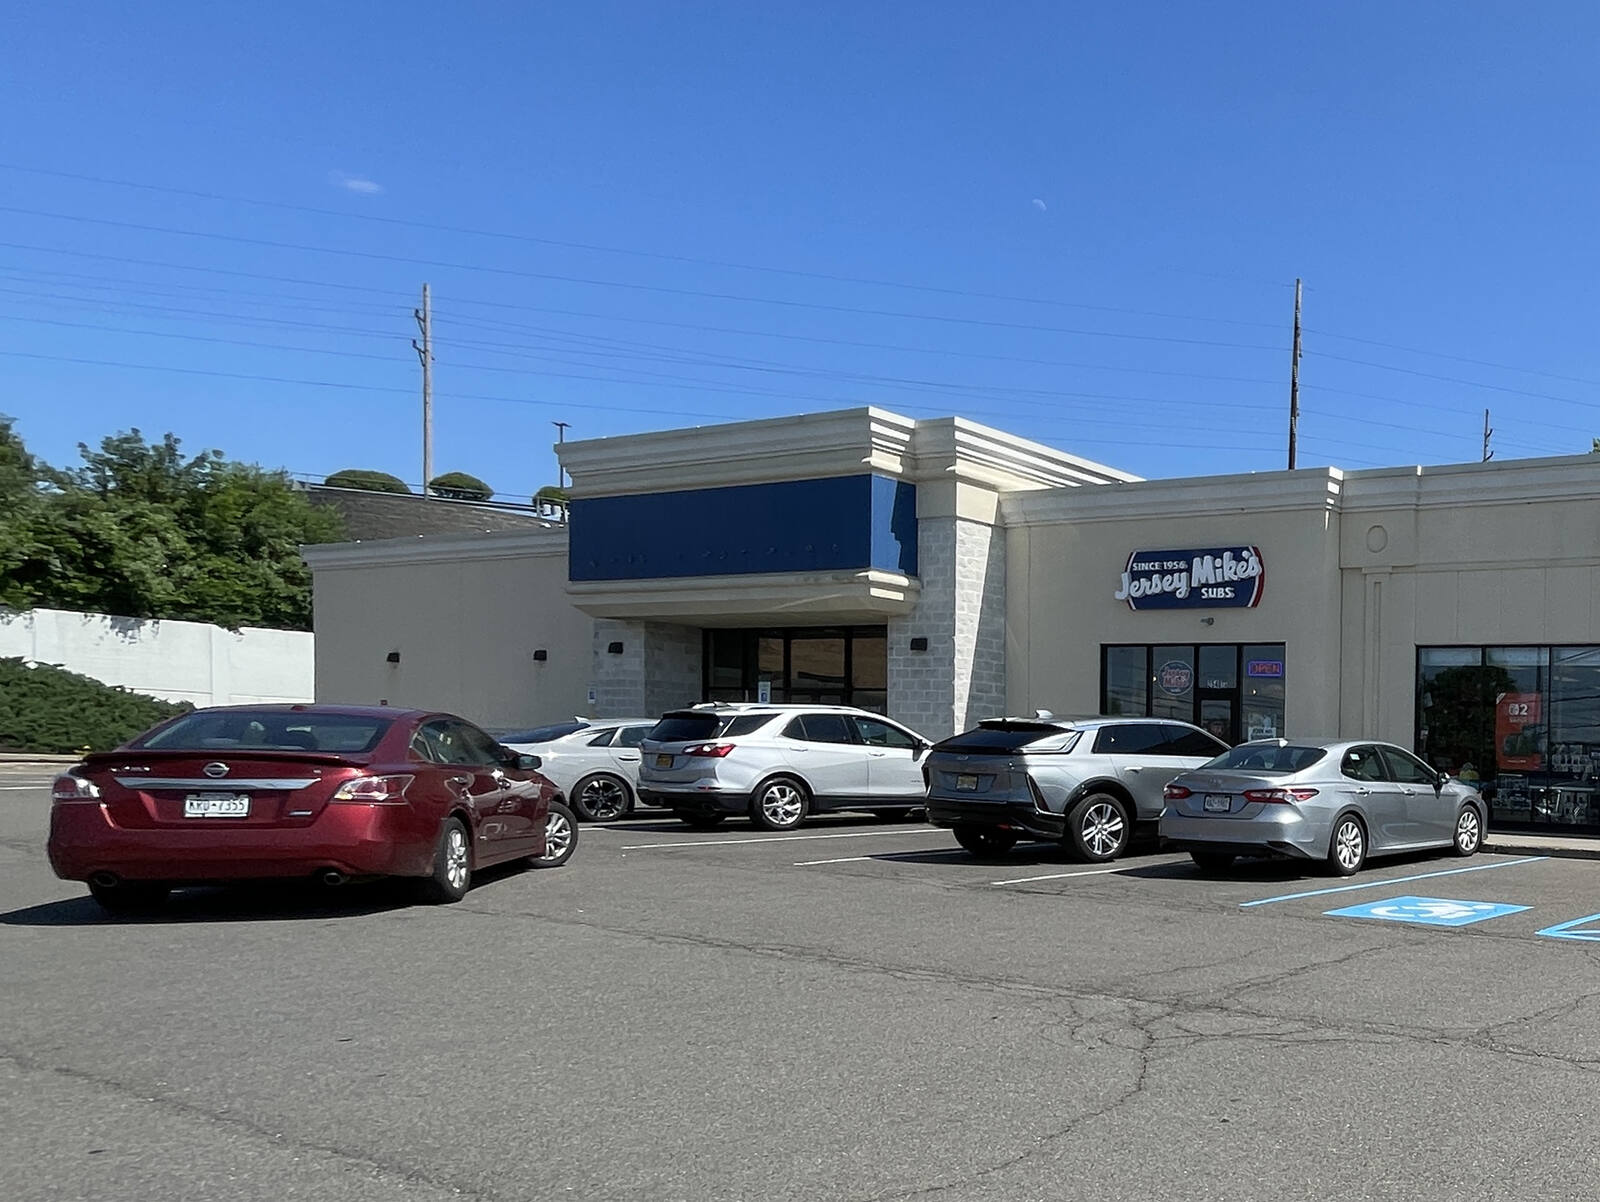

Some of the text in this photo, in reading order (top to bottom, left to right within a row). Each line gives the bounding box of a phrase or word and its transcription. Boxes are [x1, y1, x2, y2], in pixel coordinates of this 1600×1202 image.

[1132, 560, 1187, 571] SINCE 1956
[1115, 551, 1262, 600] Jersey Mike's
[1201, 587, 1234, 599] SUBS
[1251, 663, 1280, 674] OPEN
